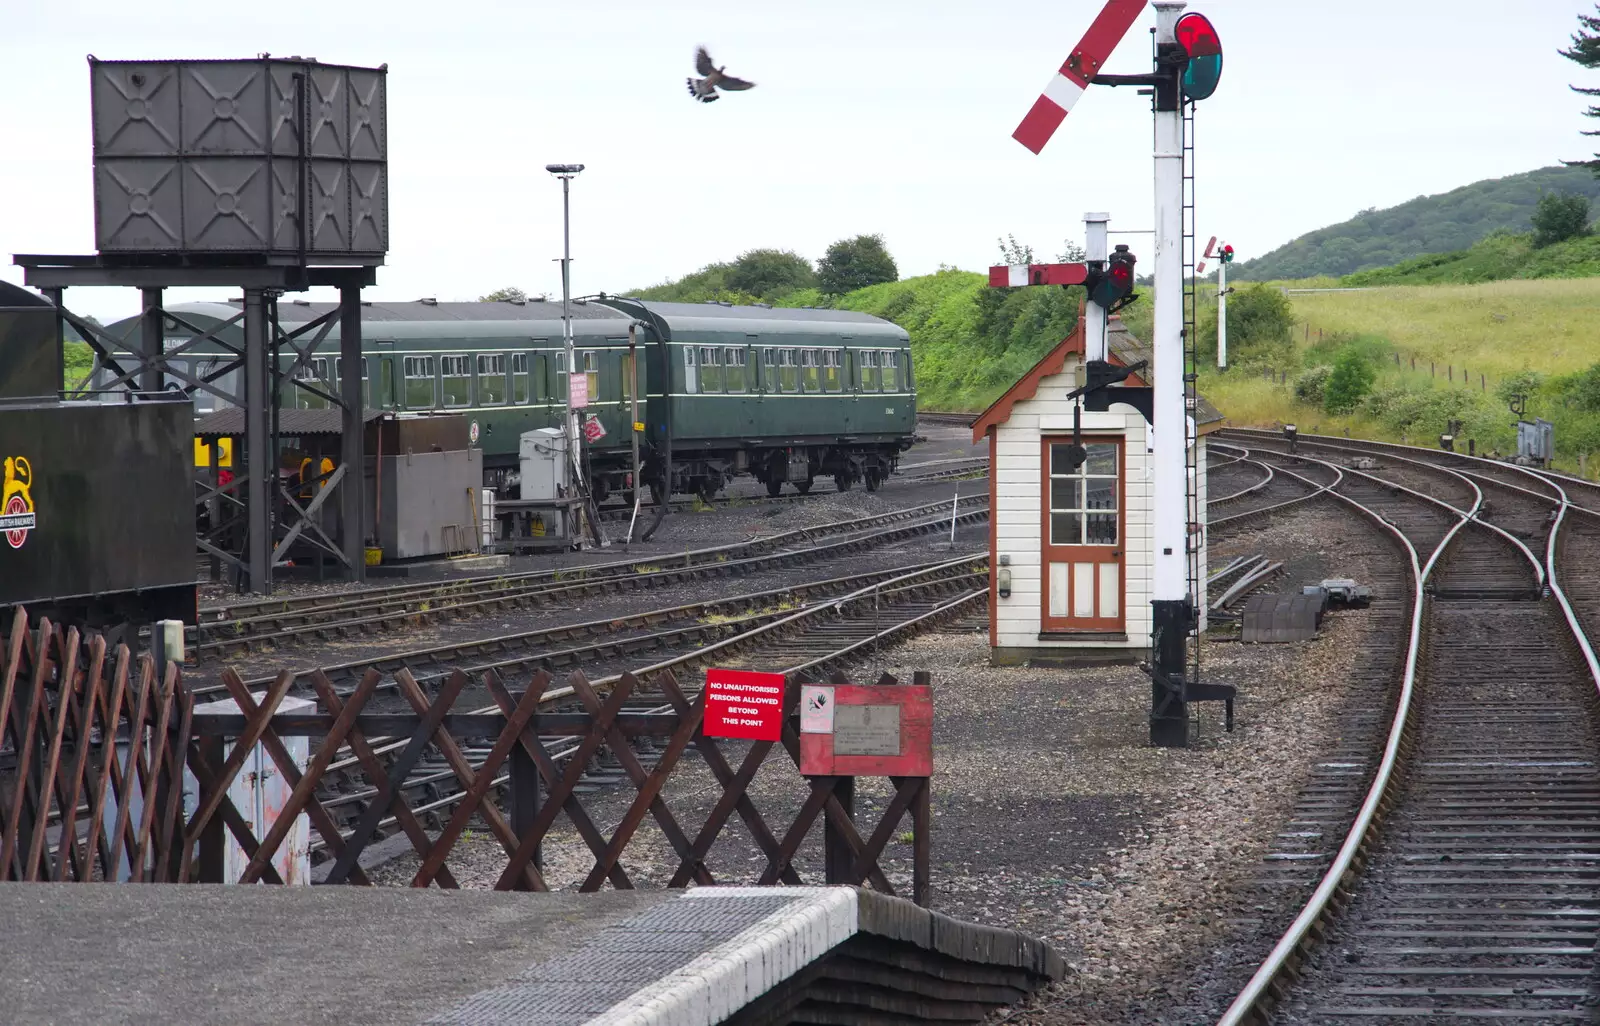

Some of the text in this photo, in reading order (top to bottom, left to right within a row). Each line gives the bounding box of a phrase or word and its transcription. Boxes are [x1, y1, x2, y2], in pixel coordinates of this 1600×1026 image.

[723, 683, 780, 694] UNAUTHORISED
[709, 693, 779, 705] PERSONS ALLOWED
[728, 706, 758, 715] BEYOND
[722, 717, 763, 727] THIS POINT
